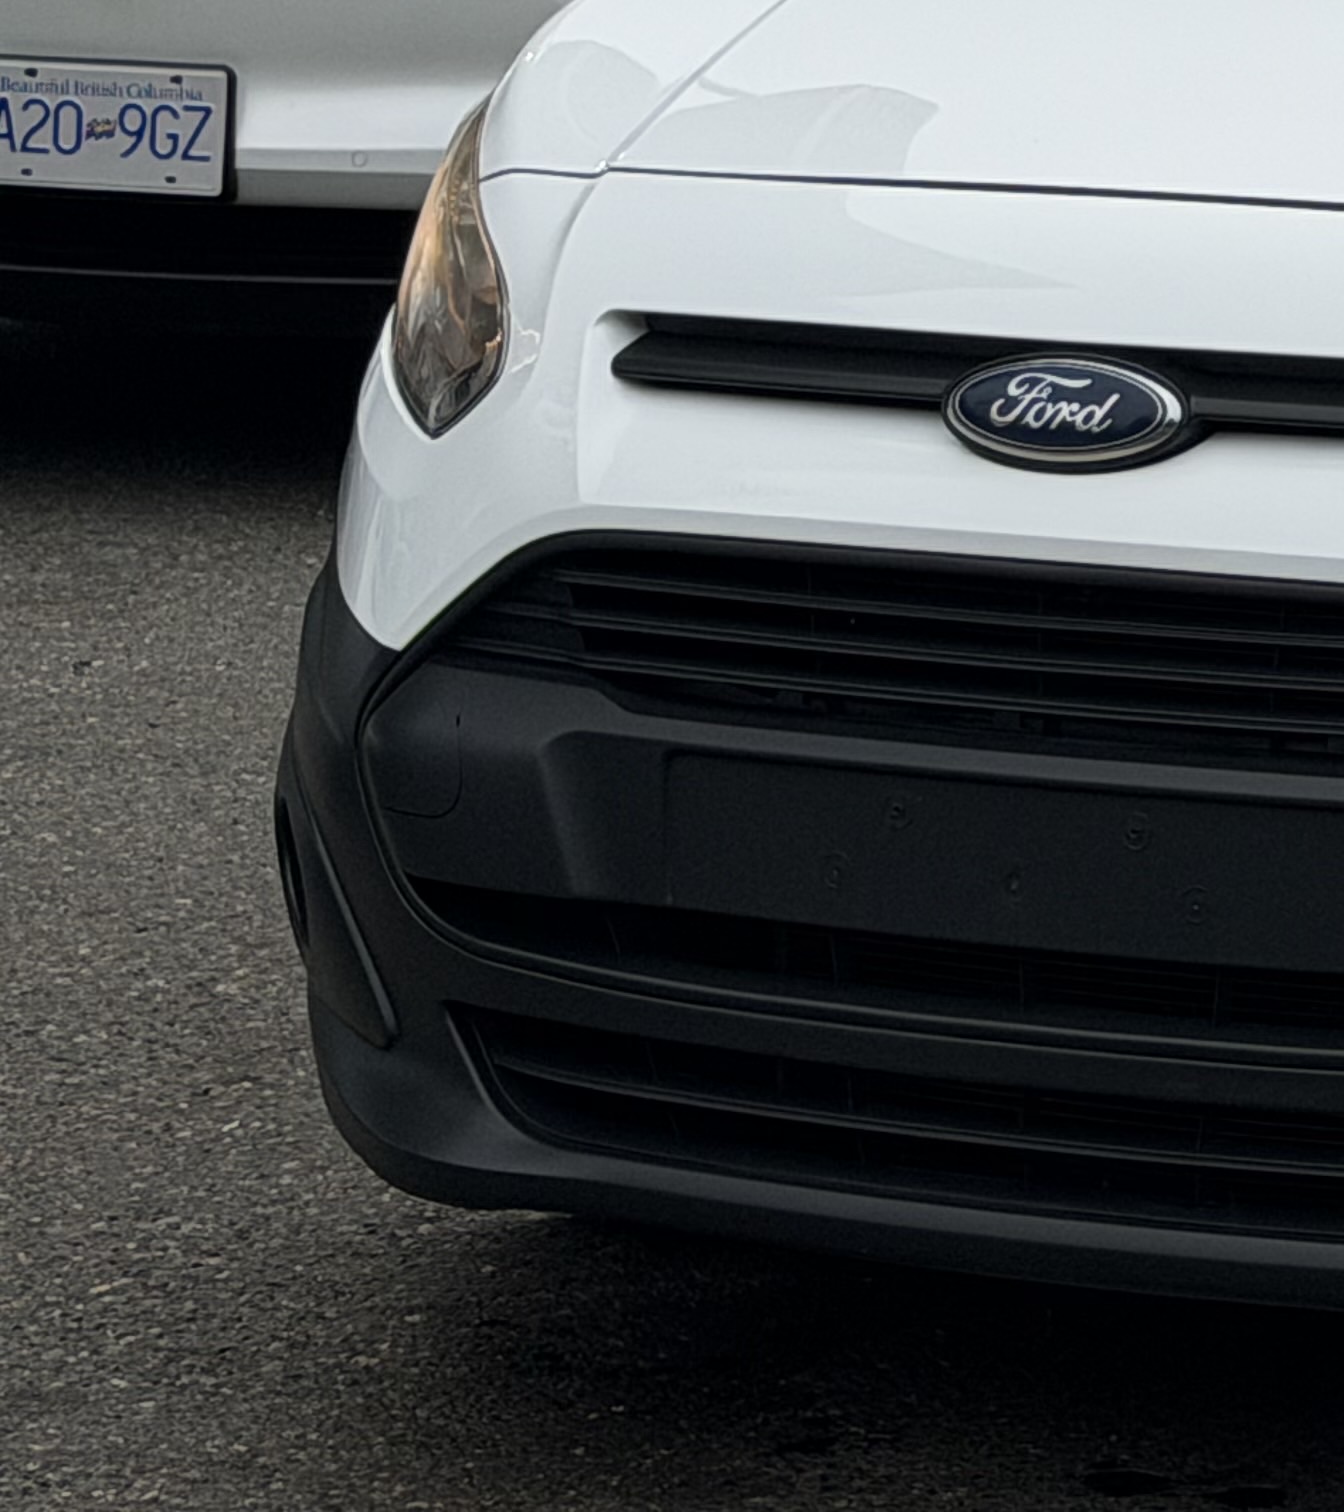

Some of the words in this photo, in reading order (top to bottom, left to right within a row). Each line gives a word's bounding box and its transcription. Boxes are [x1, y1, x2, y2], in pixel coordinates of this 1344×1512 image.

[1, 75, 70, 94] Beautiful
[74, 79, 123, 99] British
[126, 82, 203, 102] Columbia
[117, 102, 214, 163] 9GZ
[989, 372, 1121, 433] Ford
